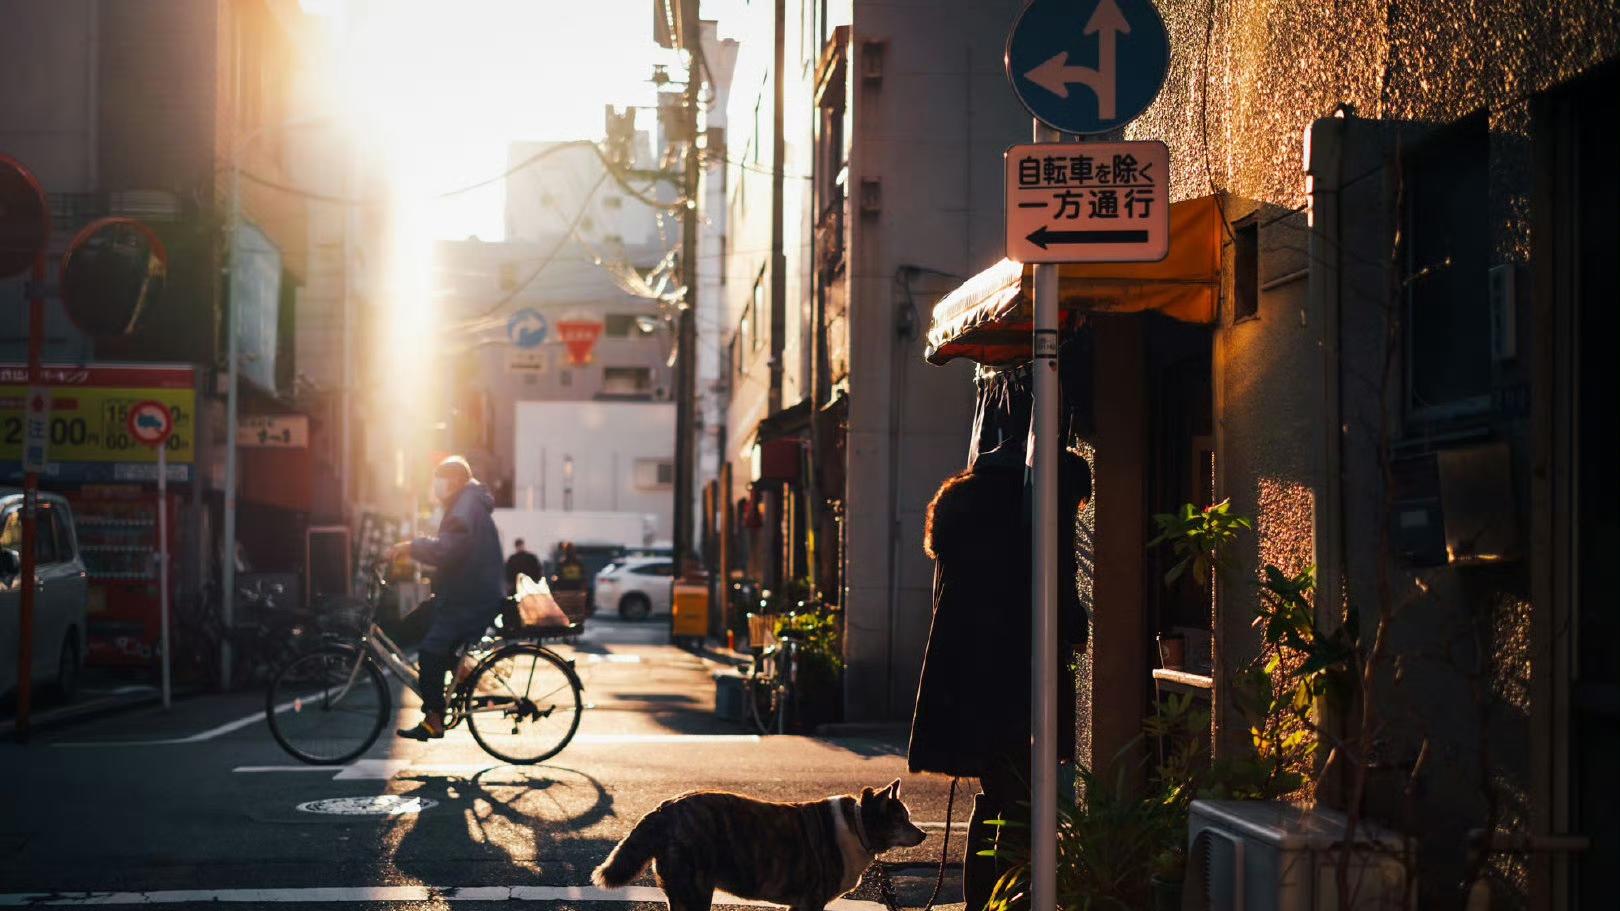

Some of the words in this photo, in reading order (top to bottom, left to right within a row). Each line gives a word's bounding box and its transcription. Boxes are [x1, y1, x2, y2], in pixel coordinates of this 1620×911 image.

[1018, 153, 1155, 186] 自転車を除く
[1018, 188, 1155, 220] 一方通行
